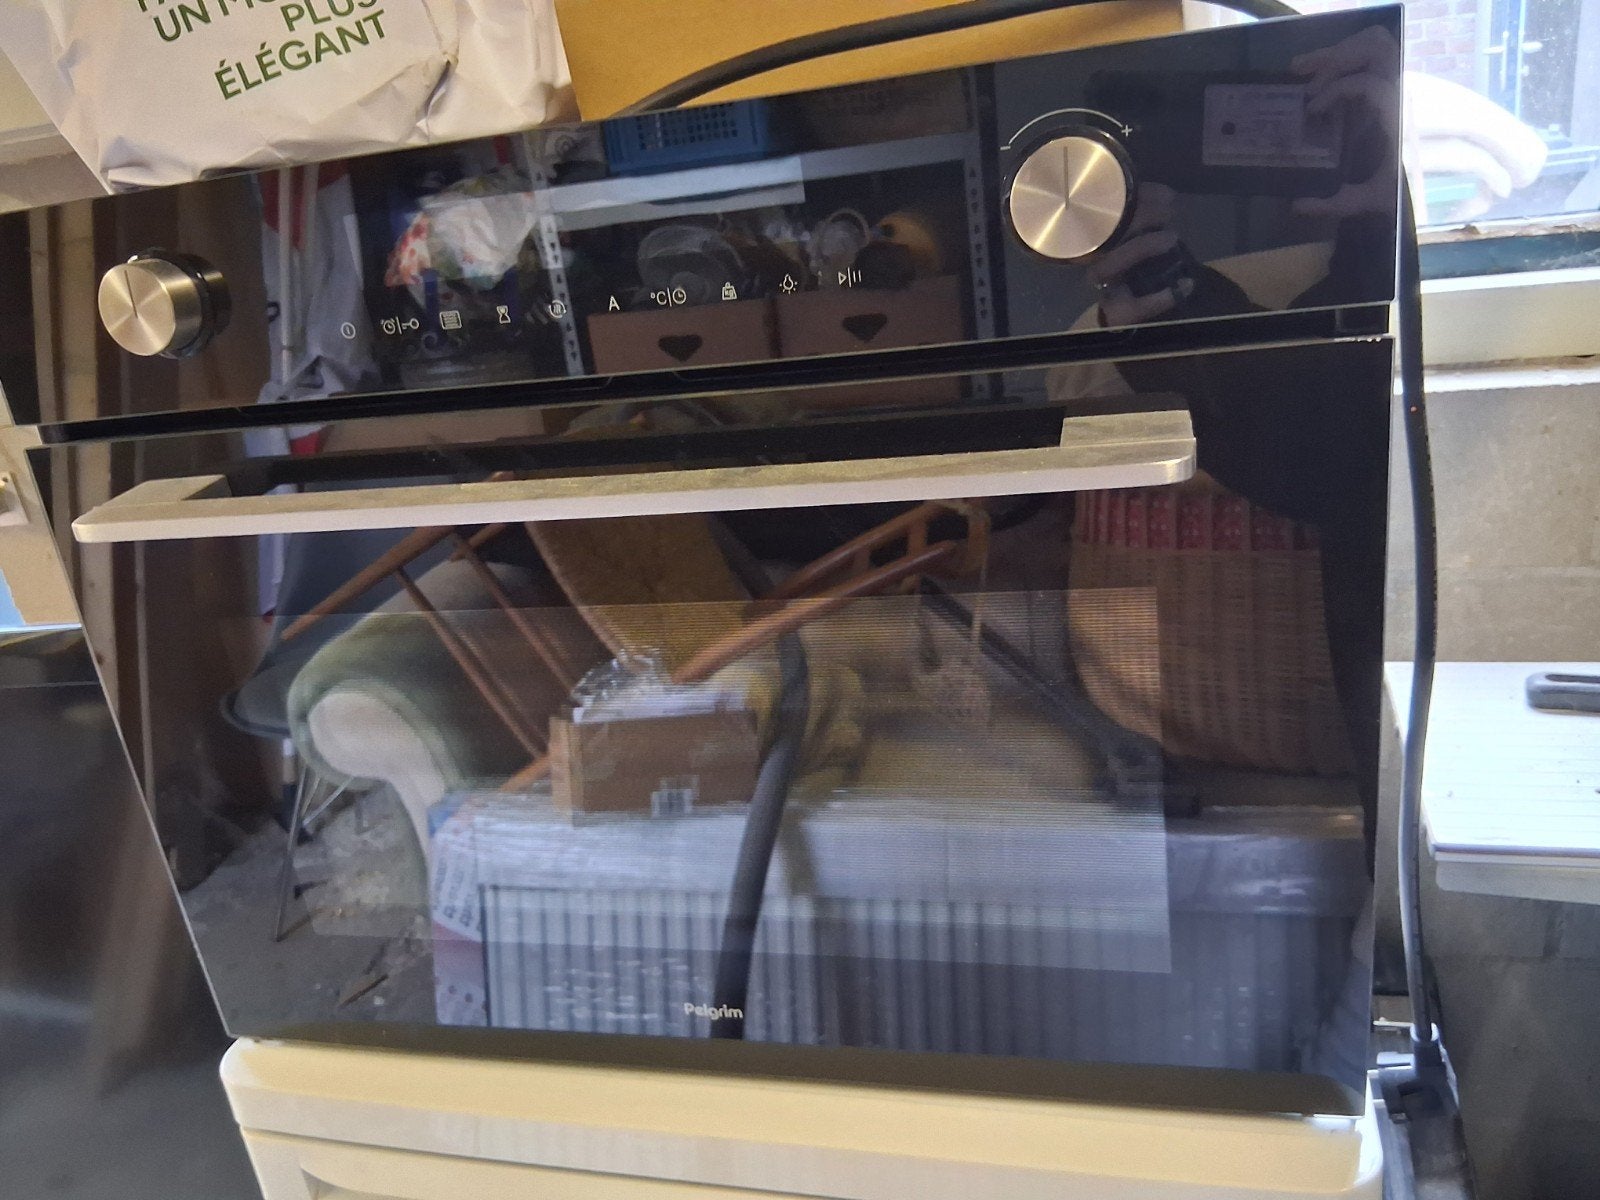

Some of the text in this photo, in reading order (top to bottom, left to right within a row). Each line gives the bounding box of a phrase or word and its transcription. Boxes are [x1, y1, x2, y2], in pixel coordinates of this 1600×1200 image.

[153, 0, 211, 42] UN
[280, 0, 378, 32] PLU
[213, 9, 386, 101] ÉLÉGANT
[608, 295, 620, 311] A
[683, 1002, 744, 1021] Pelgrim
